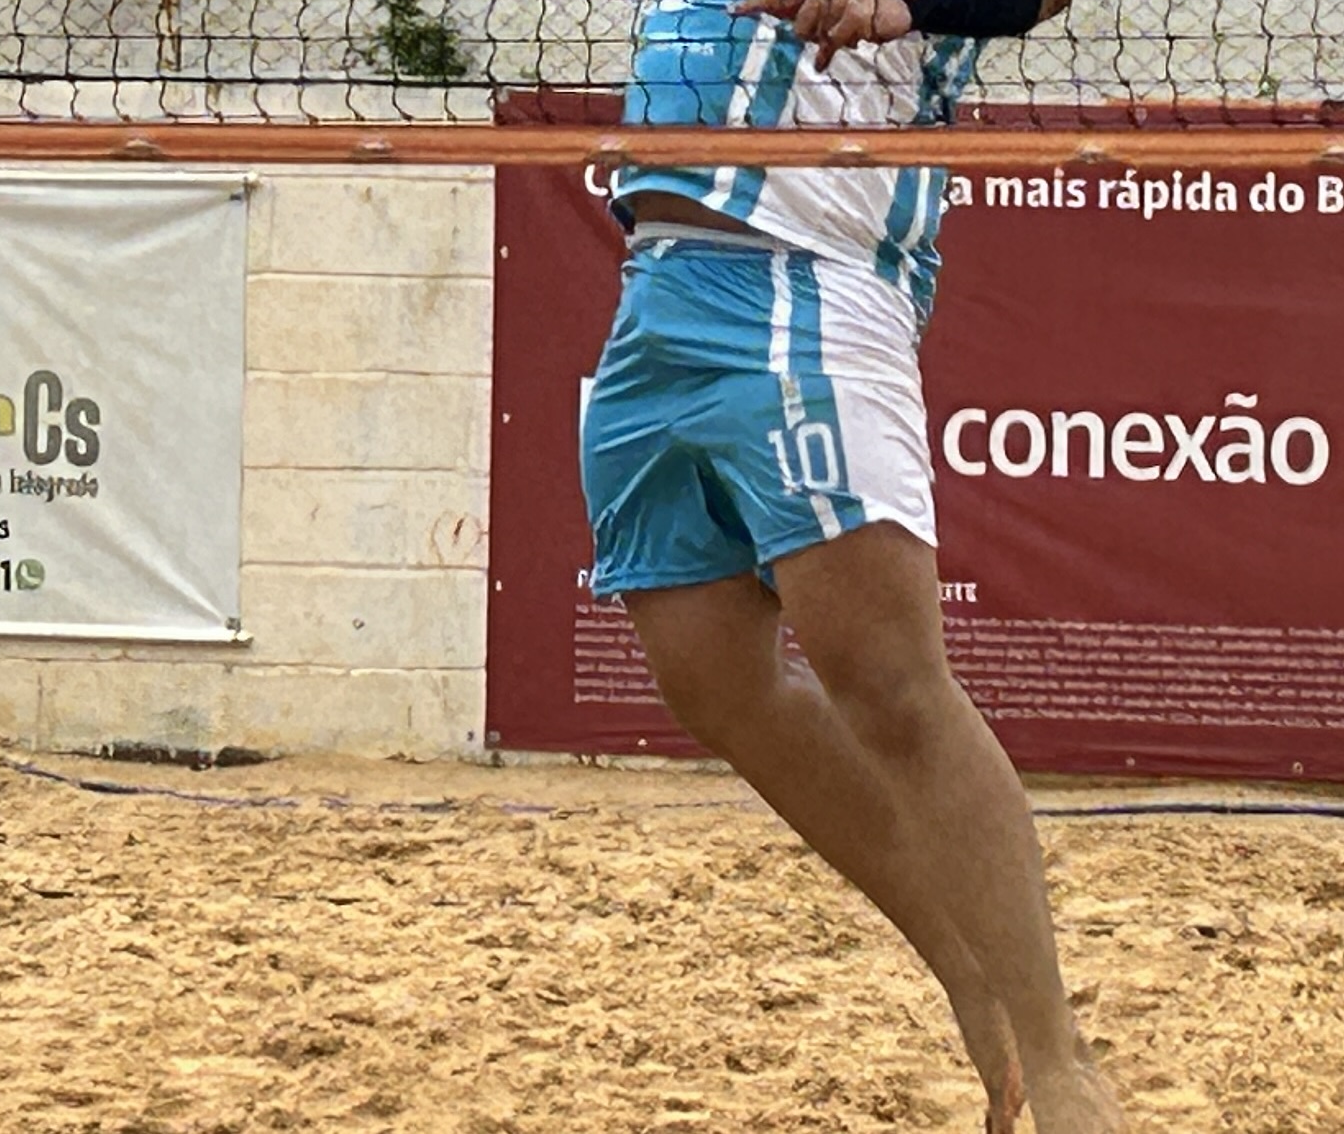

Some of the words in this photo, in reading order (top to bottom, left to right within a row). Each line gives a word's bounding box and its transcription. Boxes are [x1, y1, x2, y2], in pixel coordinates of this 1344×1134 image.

[985, 167, 1087, 208] mais
[1098, 169, 1238, 220] rápida
[1248, 171, 1305, 213] do
[767, 422, 840, 496] 10
[942, 392, 1330, 486] conexão
